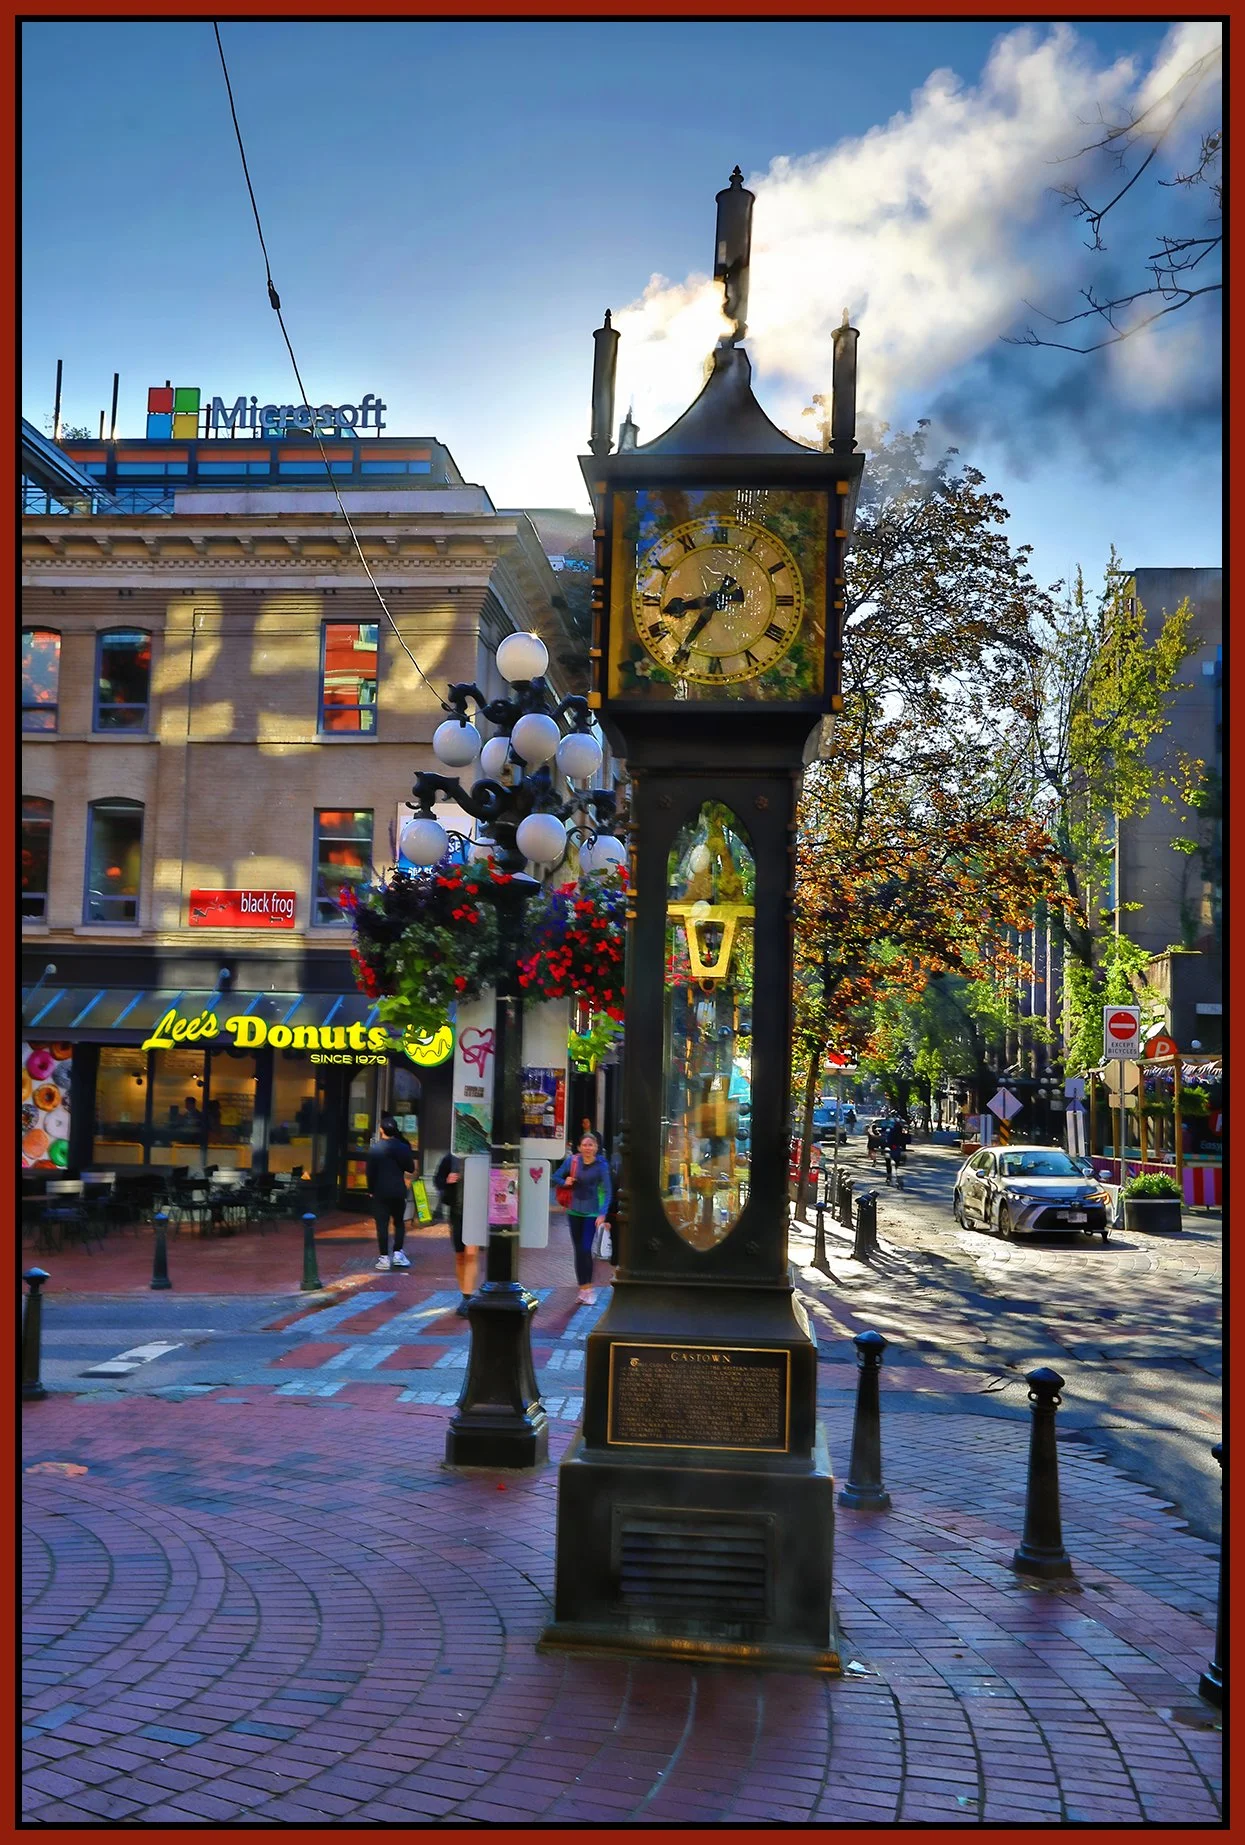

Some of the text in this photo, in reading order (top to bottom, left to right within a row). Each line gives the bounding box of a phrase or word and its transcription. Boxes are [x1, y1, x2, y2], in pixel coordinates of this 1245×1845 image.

[211, 393, 387, 429] Microsoft
[240, 892, 294, 918] black frog
[141, 1008, 389, 1051] Lee's Donuts
[310, 1054, 389, 1065] SINCE 1979
[670, 1352, 732, 1363] GASTOWN
